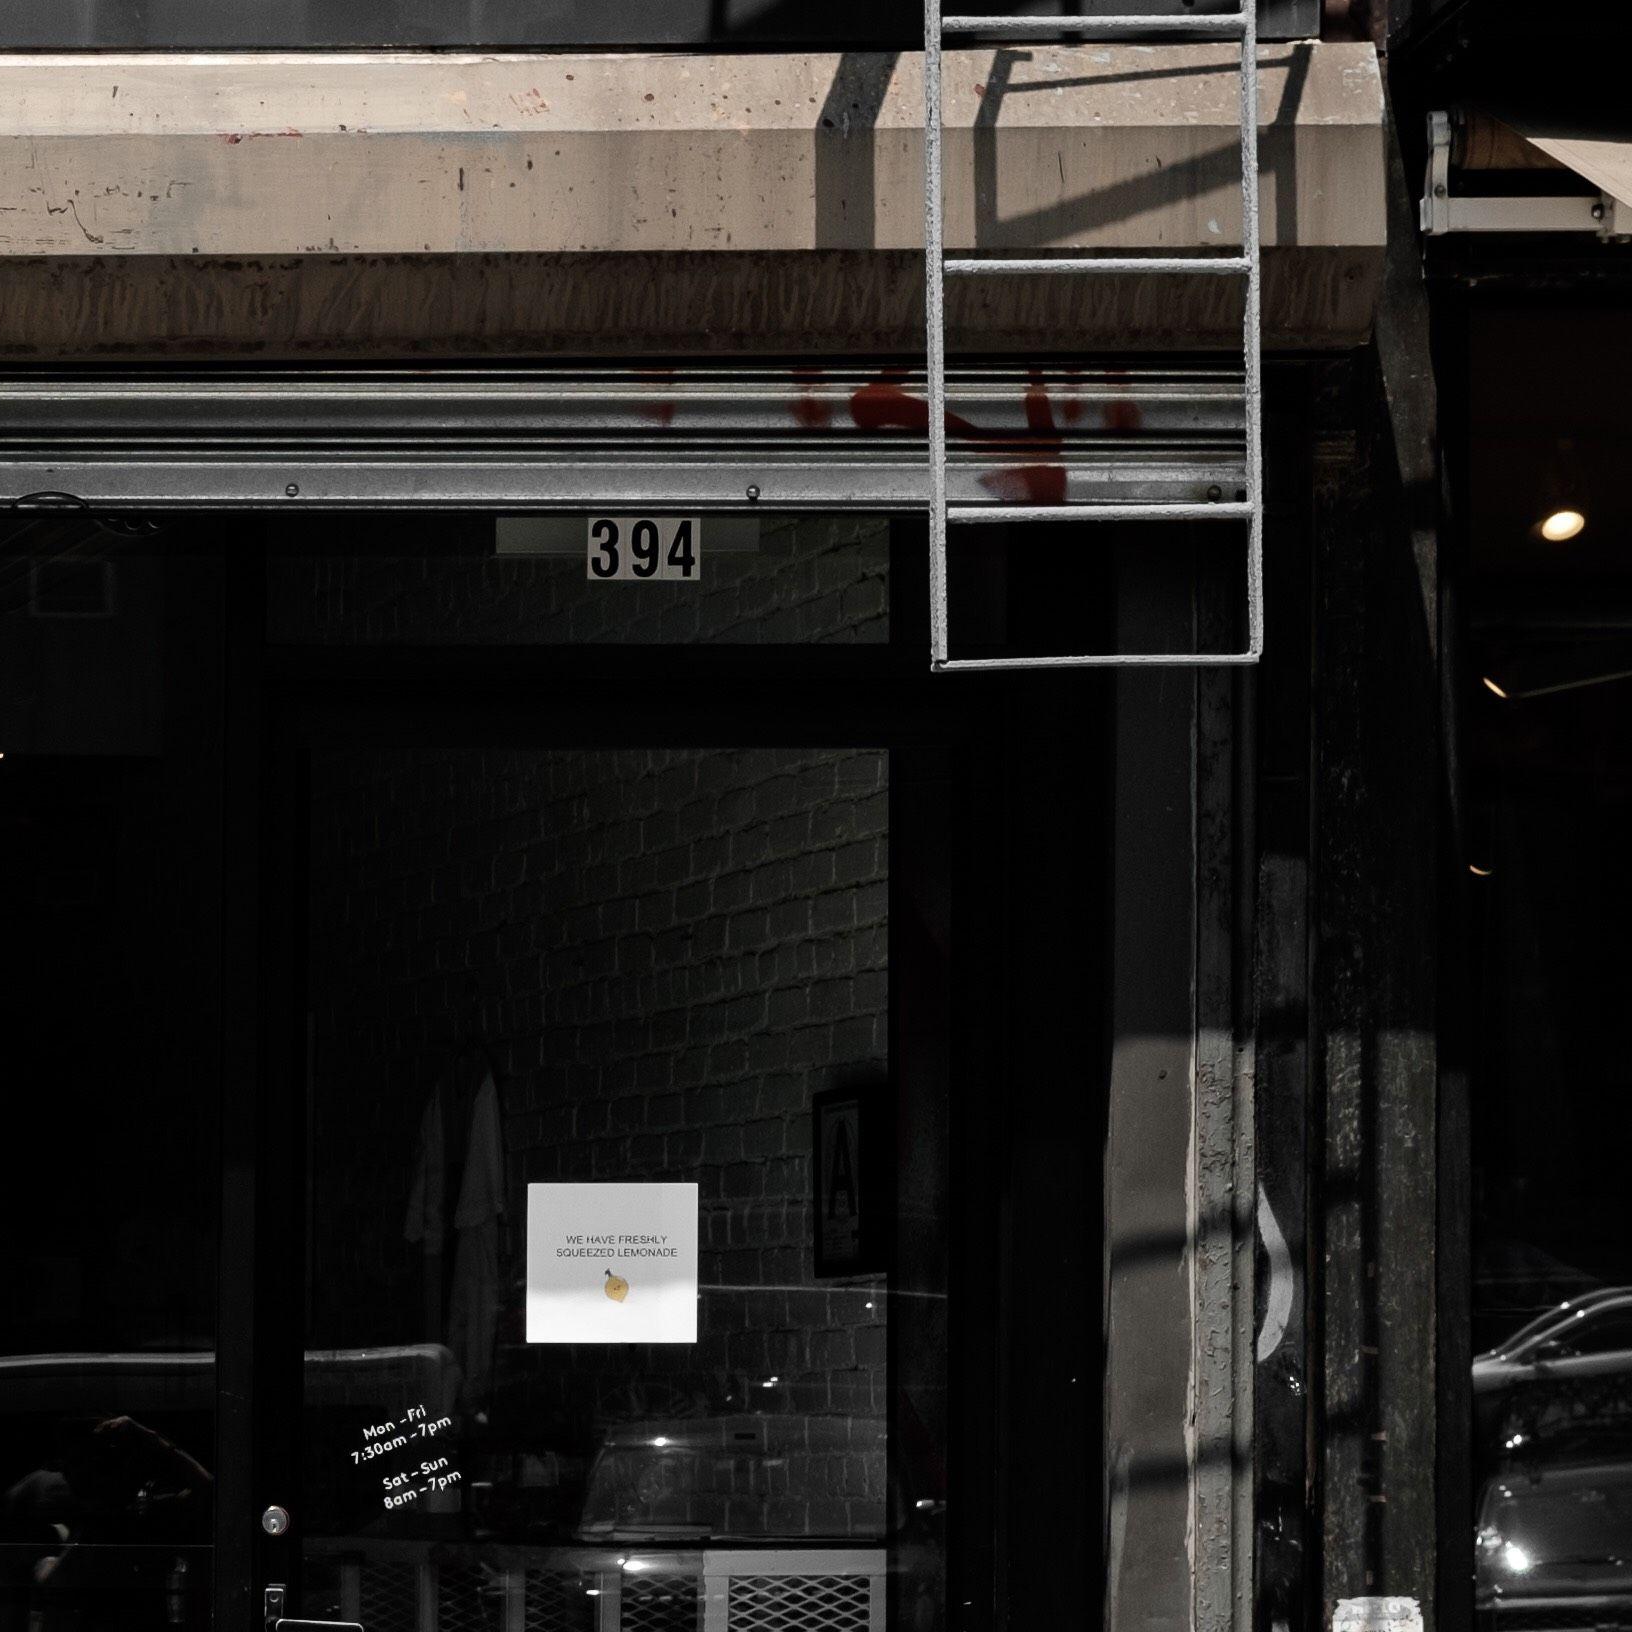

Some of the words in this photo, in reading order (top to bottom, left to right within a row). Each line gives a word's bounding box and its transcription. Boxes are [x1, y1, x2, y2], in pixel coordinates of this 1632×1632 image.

[591, 519, 696, 578] 394
[556, 1248, 615, 1258] SQUEEZED
[618, 1248, 678, 1258] LEMONADE
[566, 1235, 583, 1244] WE
[586, 1235, 615, 1244] HAVE
[618, 1235, 667, 1244] FRESHLY
[351, 1436, 407, 1464] 7:30am
[418, 1417, 452, 1436] 7pm
[363, 1421, 395, 1440] Mon
[383, 1472, 409, 1489] Sat
[420, 1457, 448, 1475] Sun
[383, 1490, 417, 1509] 8am
[428, 1471, 462, 1491] 7pm
